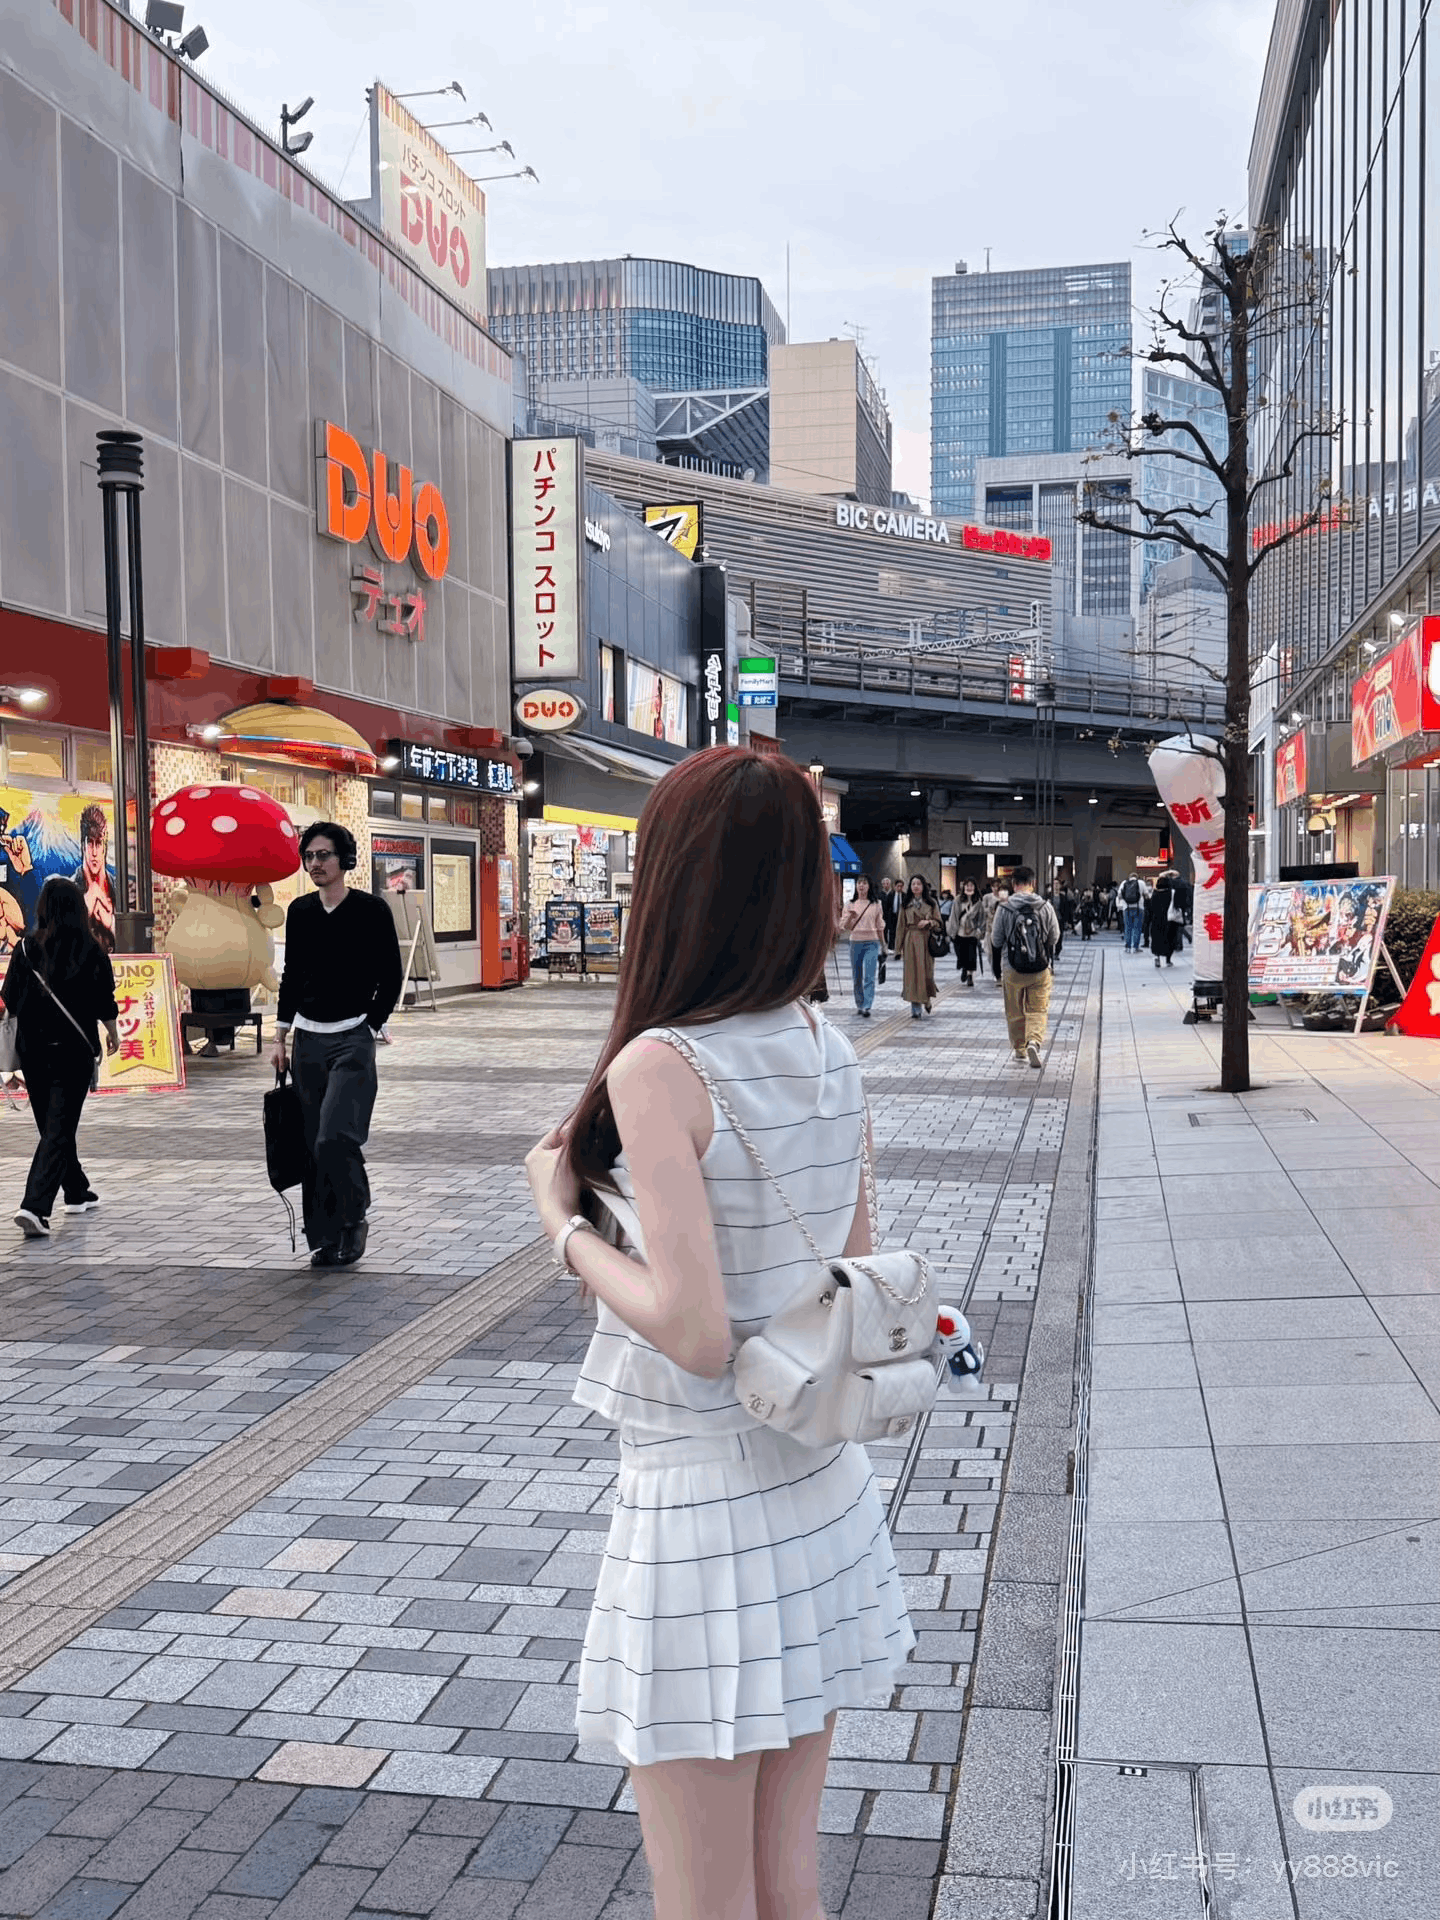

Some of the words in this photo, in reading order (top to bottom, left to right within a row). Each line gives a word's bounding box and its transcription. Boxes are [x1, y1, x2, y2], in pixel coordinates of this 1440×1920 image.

[400, 170, 471, 288] DUO
[322, 419, 450, 581] DUO
[532, 447, 558, 553] パチンコ
[836, 502, 869, 530] BIC
[873, 510, 950, 544] CAMERA
[534, 564, 557, 668] スロット
[523, 701, 575, 719] DUO
[142, 991, 157, 1058] 公式サポーター
